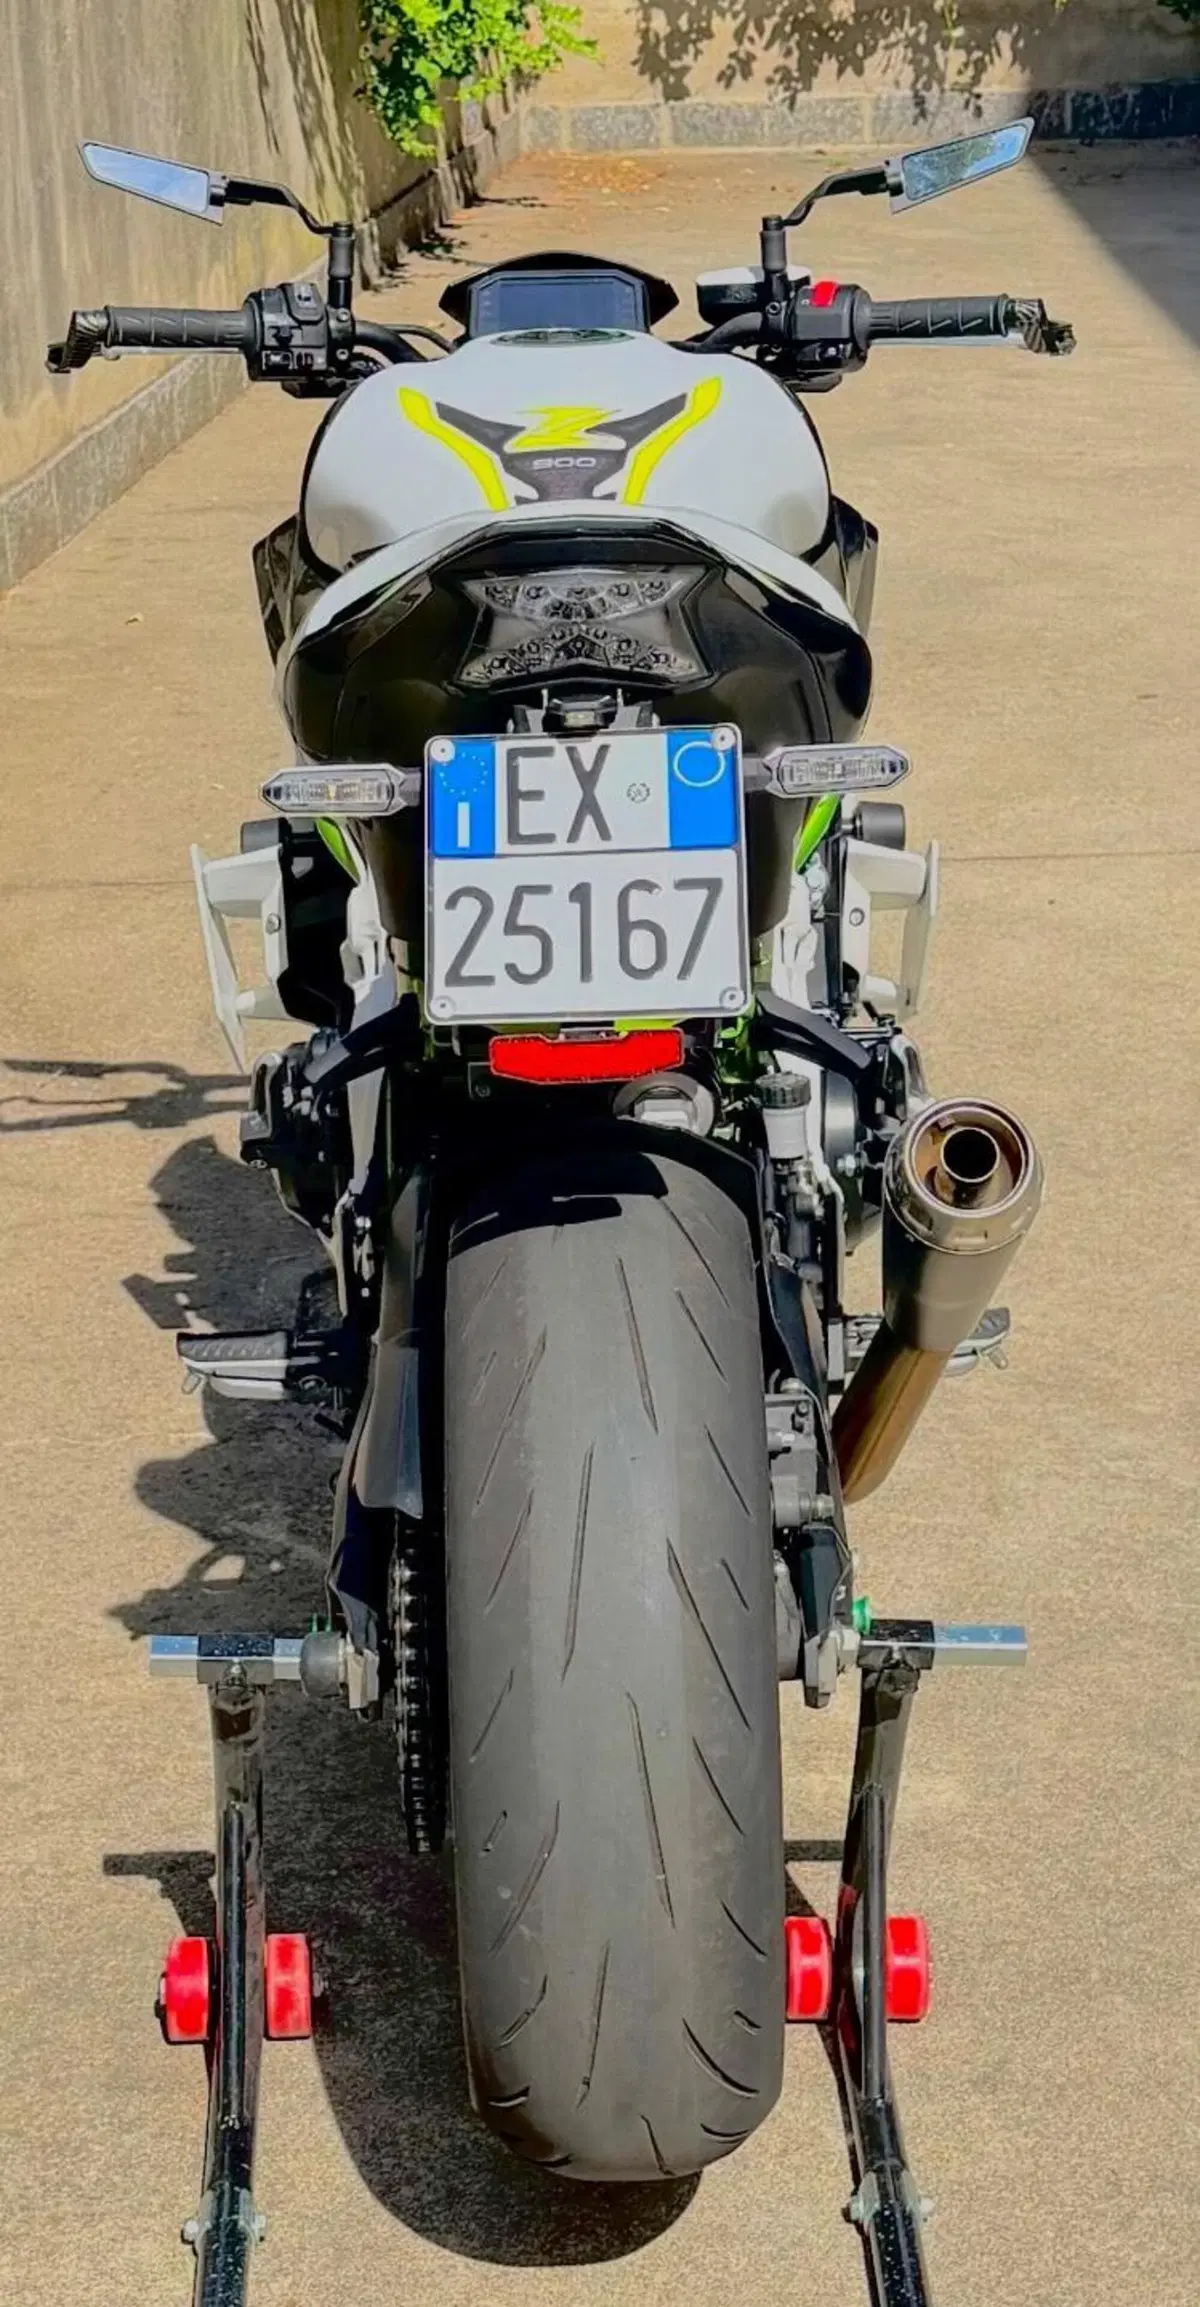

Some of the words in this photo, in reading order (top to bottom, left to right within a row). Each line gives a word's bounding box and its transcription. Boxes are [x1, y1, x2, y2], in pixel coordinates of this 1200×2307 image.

[532, 456, 597, 470] 900
[457, 801, 471, 848] I
[506, 744, 612, 845] EX
[444, 877, 723, 988] 25167
